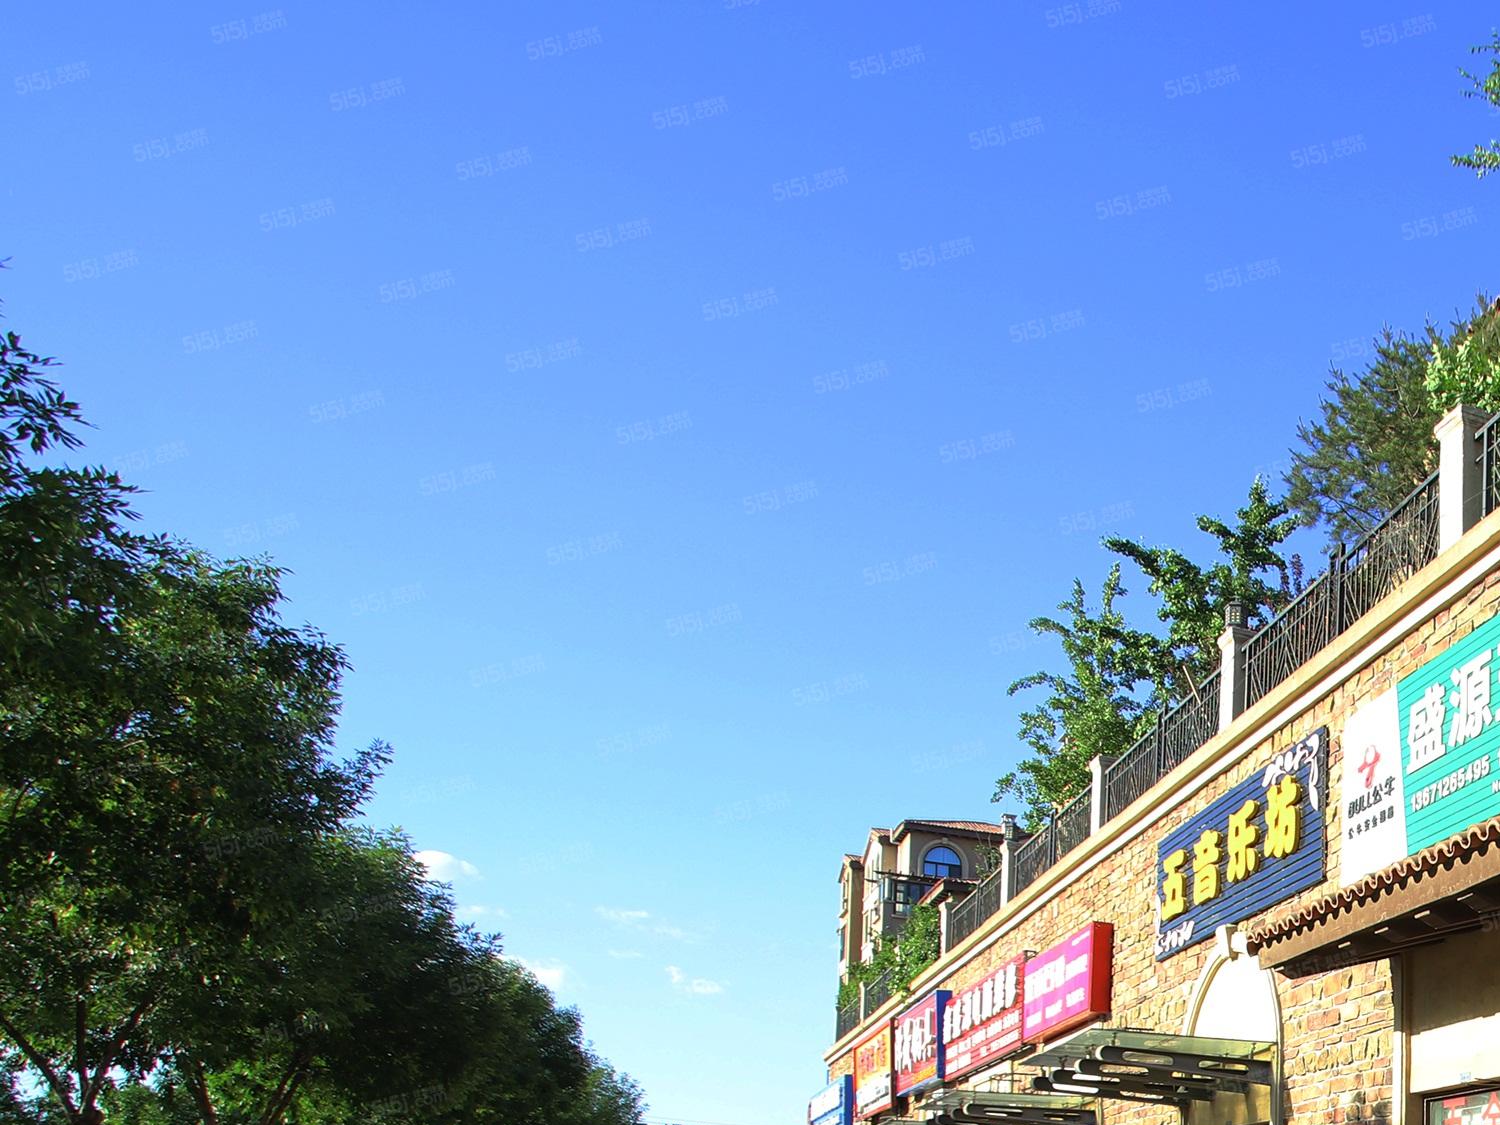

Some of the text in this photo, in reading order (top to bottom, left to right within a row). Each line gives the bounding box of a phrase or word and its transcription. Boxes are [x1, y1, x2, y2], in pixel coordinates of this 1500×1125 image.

[1410, 755, 1491, 813] 13671265495
[1160, 775, 1300, 921] 五音乐坊
